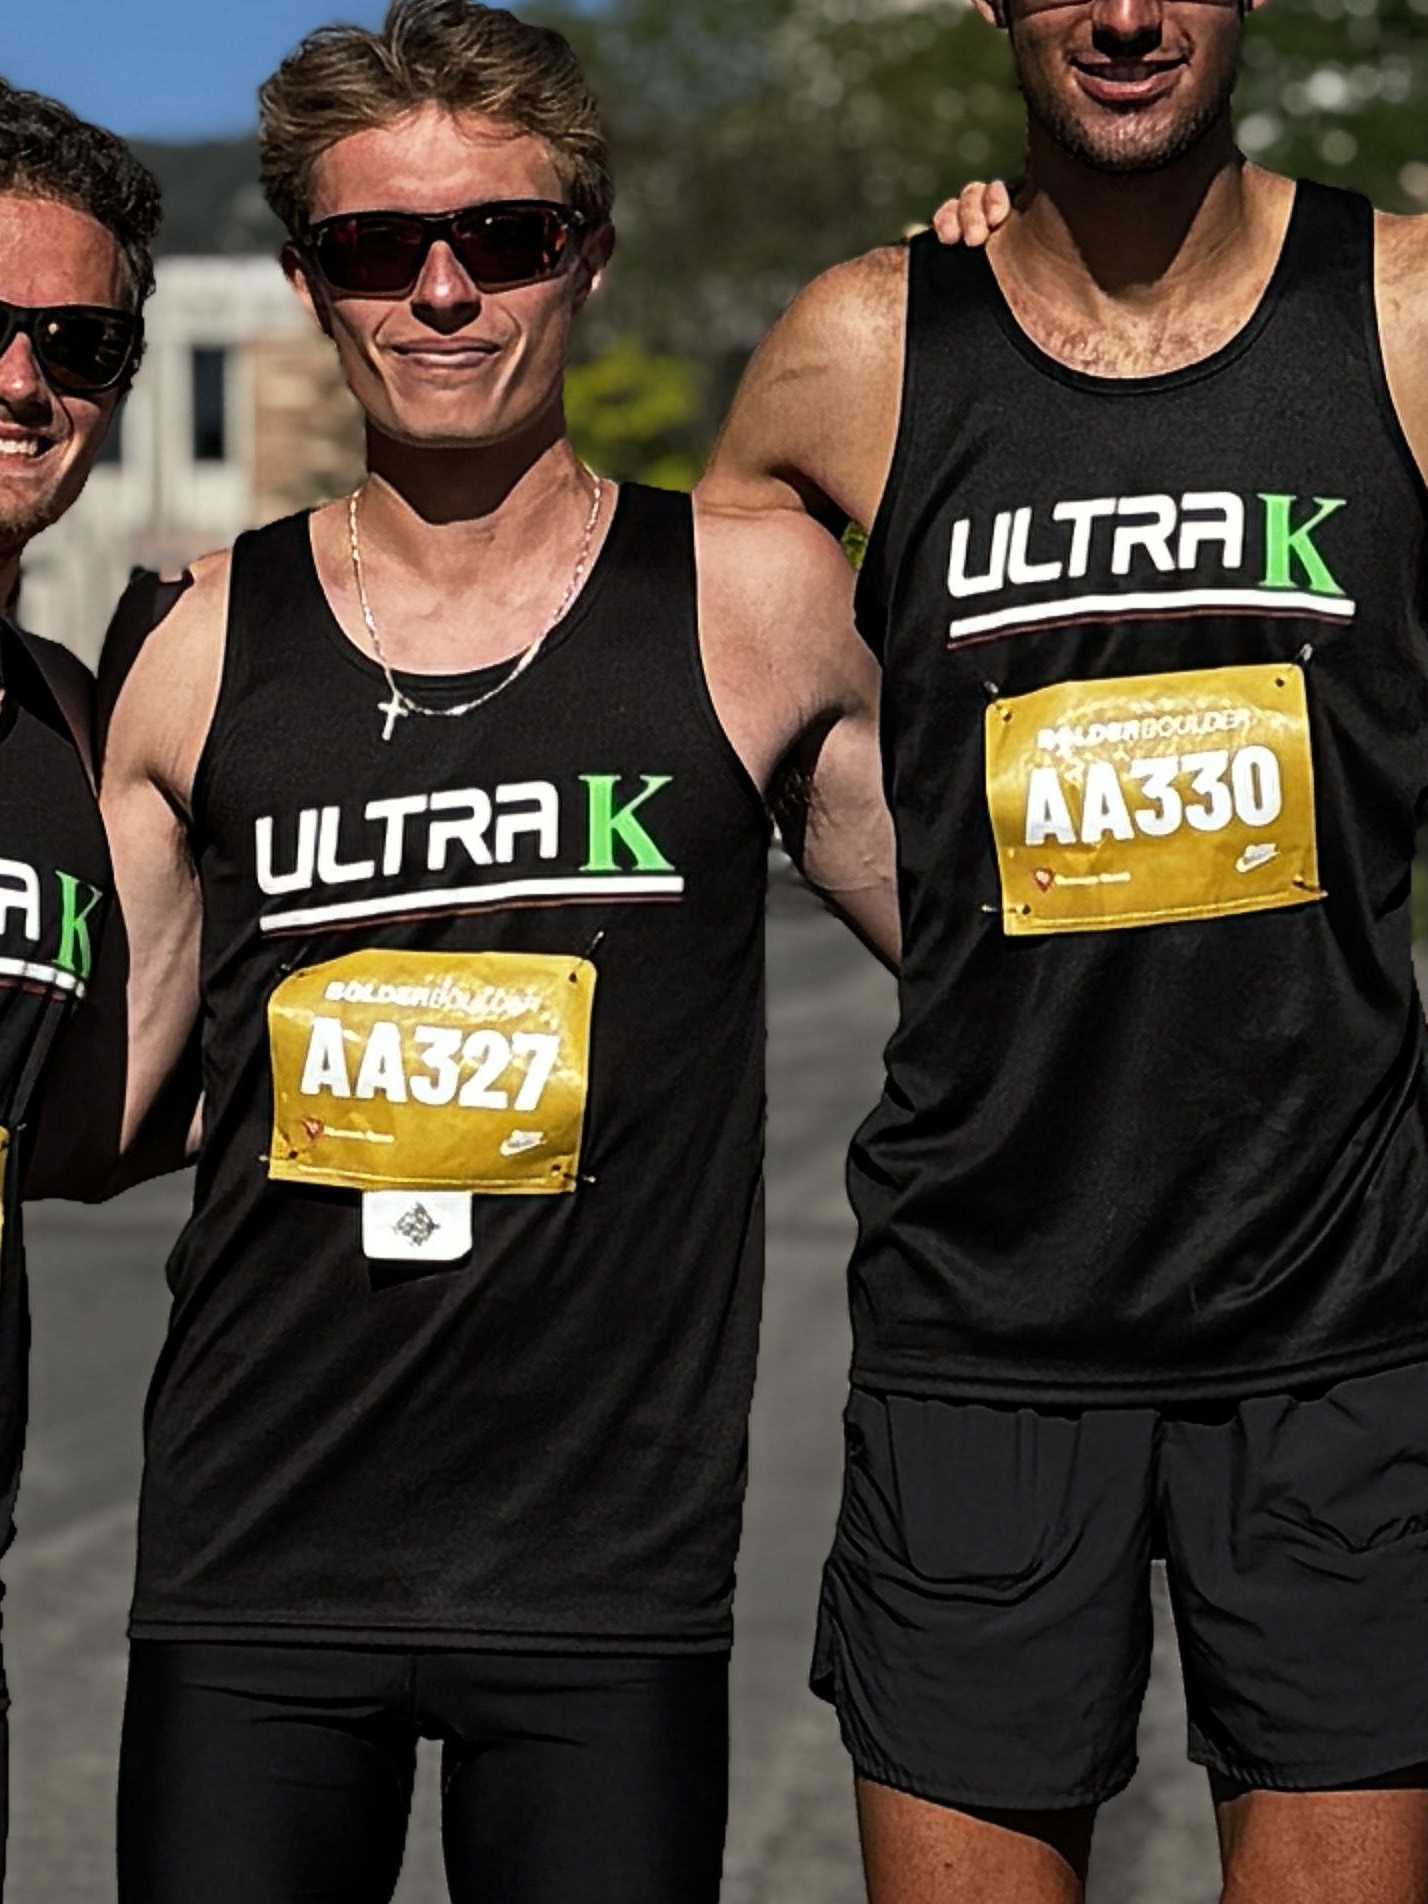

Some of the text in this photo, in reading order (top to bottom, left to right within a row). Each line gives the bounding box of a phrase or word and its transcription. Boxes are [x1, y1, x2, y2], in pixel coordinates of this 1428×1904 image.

[947, 491, 1245, 597] ULTRA
[255, 774, 675, 895] ULTRA K
[1024, 744, 1283, 846] AA330
[299, 1016, 561, 1112] AA327
